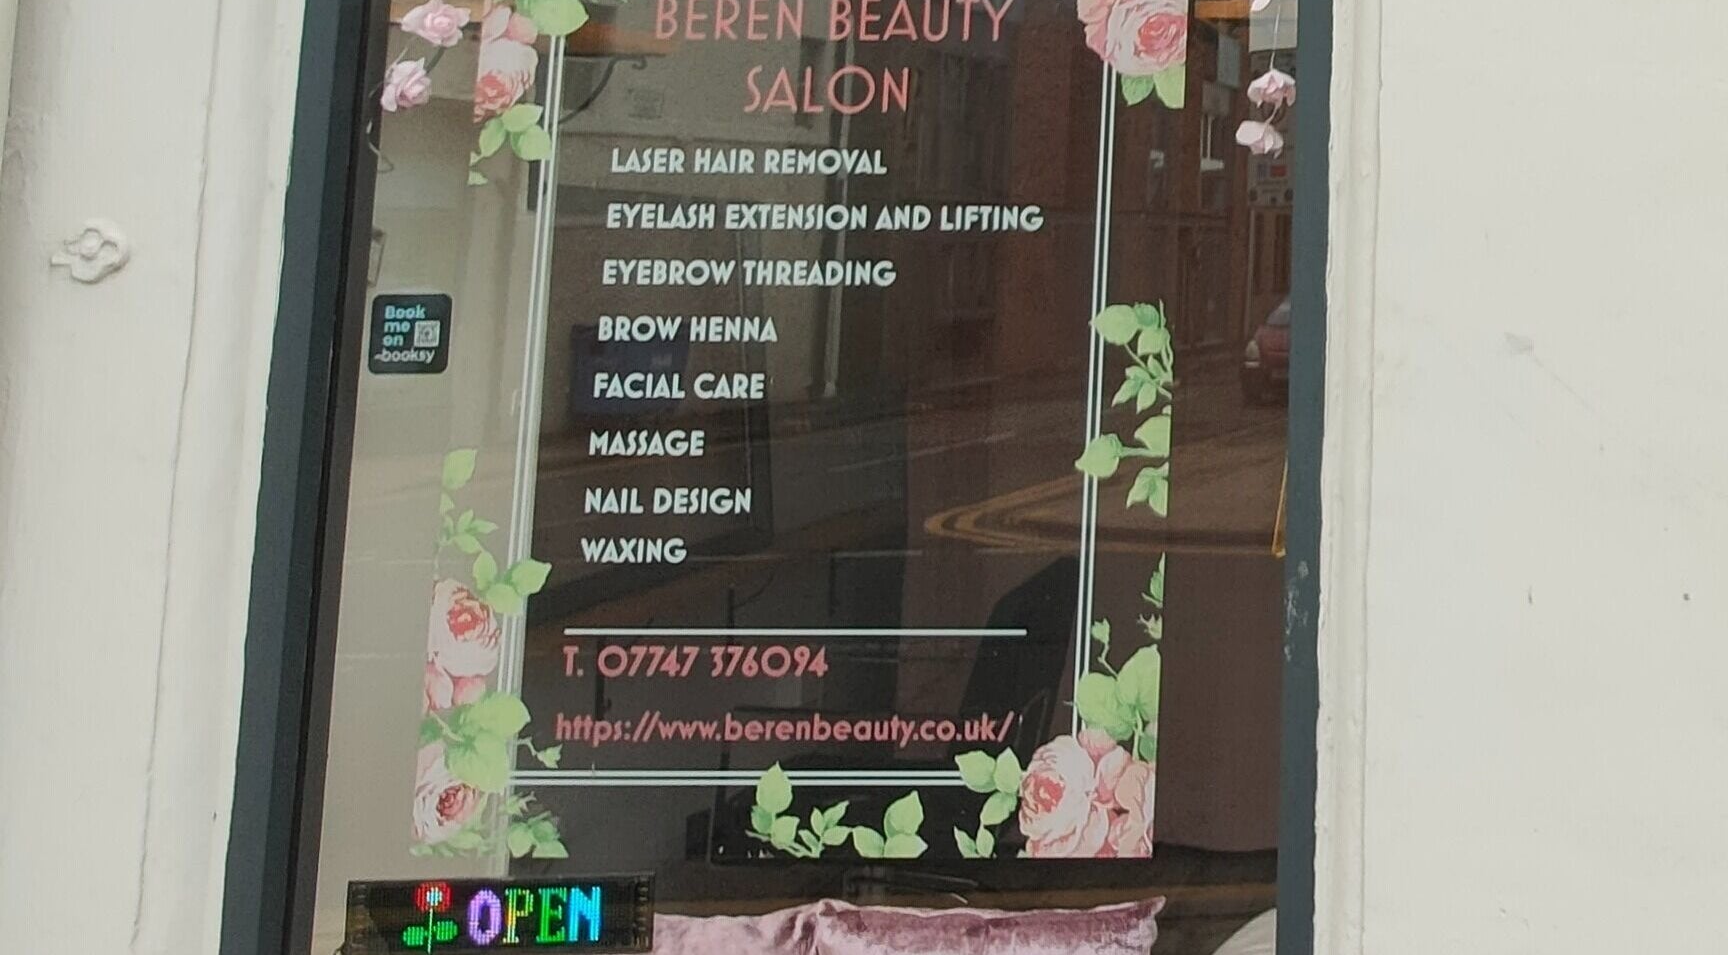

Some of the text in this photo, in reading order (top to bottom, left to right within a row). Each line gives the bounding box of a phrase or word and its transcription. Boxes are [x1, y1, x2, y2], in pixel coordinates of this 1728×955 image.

[744, 65, 909, 114] SALON
[611, 147, 887, 175] LASER HAIR REMOVAL
[606, 202, 1044, 232] EYELASH EXTENSION AND LIFTING
[602, 259, 897, 287] EYEBROW THREADING
[384, 304, 426, 319] Book
[383, 334, 404, 347] on
[598, 316, 778, 343] BROW HENNA
[593, 372, 765, 399] FACIAL CARE
[588, 429, 705, 456] MASSAGE
[584, 487, 752, 514] NAIL DESIGN
[580, 537, 688, 564] WAXING
[562, 645, 829, 678] T. 07747 376094
[555, 711, 1014, 746] https://www.berenbeauty.co.uk/
[467, 886, 601, 945] OPEN
